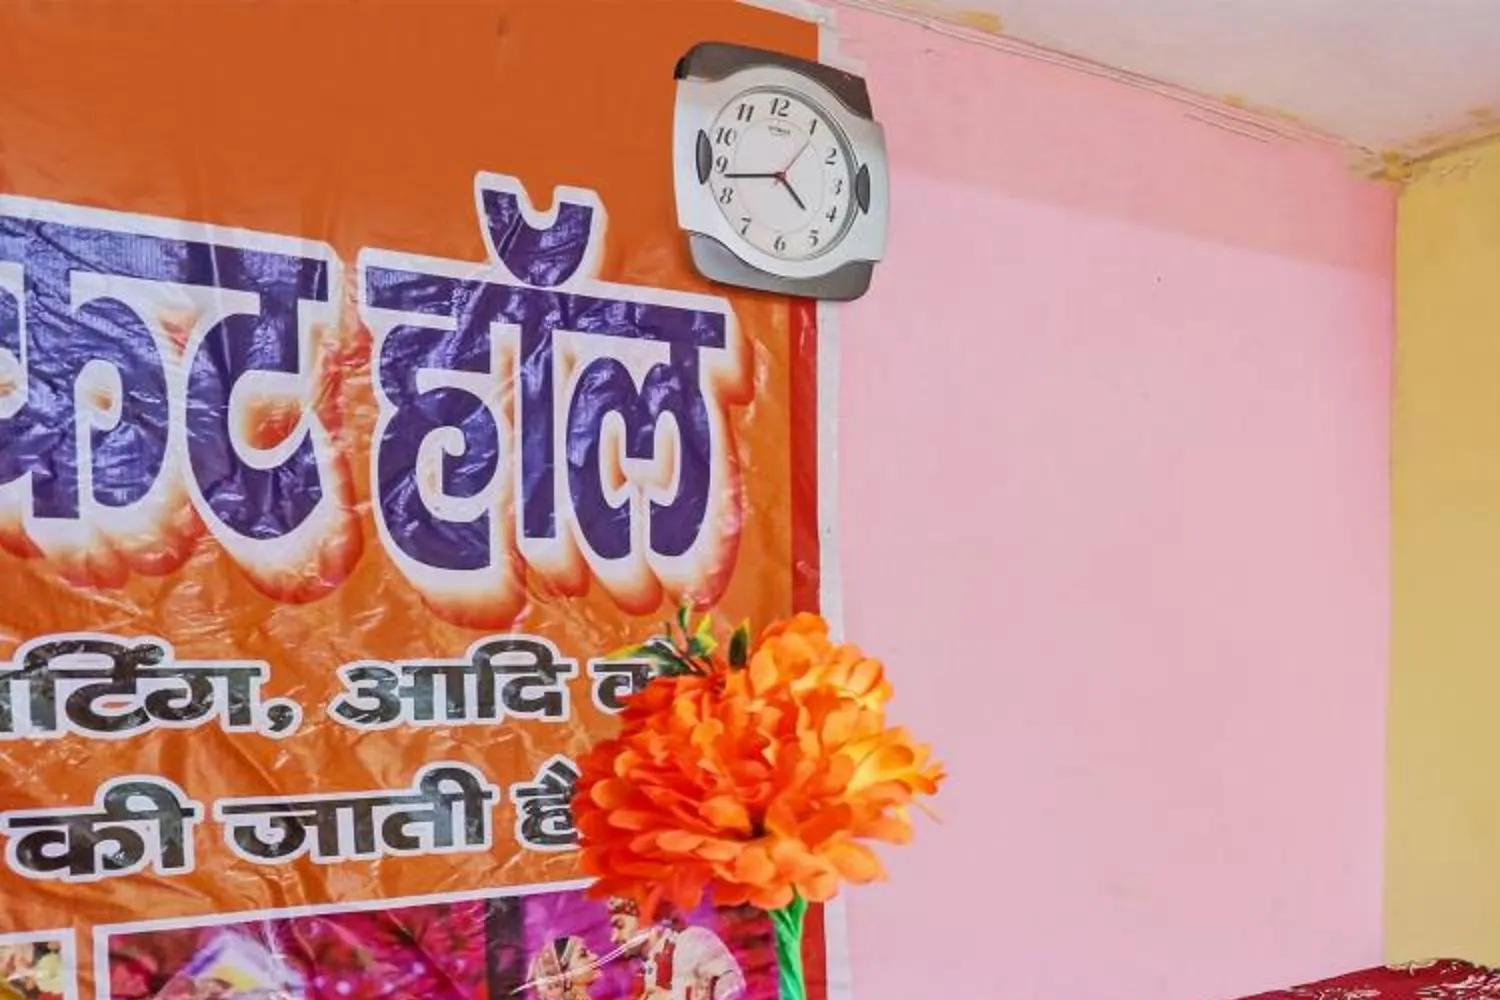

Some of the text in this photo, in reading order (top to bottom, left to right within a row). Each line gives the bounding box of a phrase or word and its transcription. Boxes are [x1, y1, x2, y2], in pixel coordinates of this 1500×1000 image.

[737, 103, 755, 122] 11
[770, 97, 790, 117] 12
[809, 118, 818, 136] 1
[715, 127, 737, 146] 10
[715, 155, 729, 173] 9
[824, 147, 837, 165] 2
[833, 178, 843, 195] 3
[718, 187, 734, 205] 8
[825, 206, 837, 223] 4
[740, 217, 752, 236] 7
[773, 235, 786, 251] 6
[808, 229, 819, 246] 5
[335, 639, 572, 724] आदि
[9, 782, 194, 875] की
[222, 767, 491, 858] जाती
